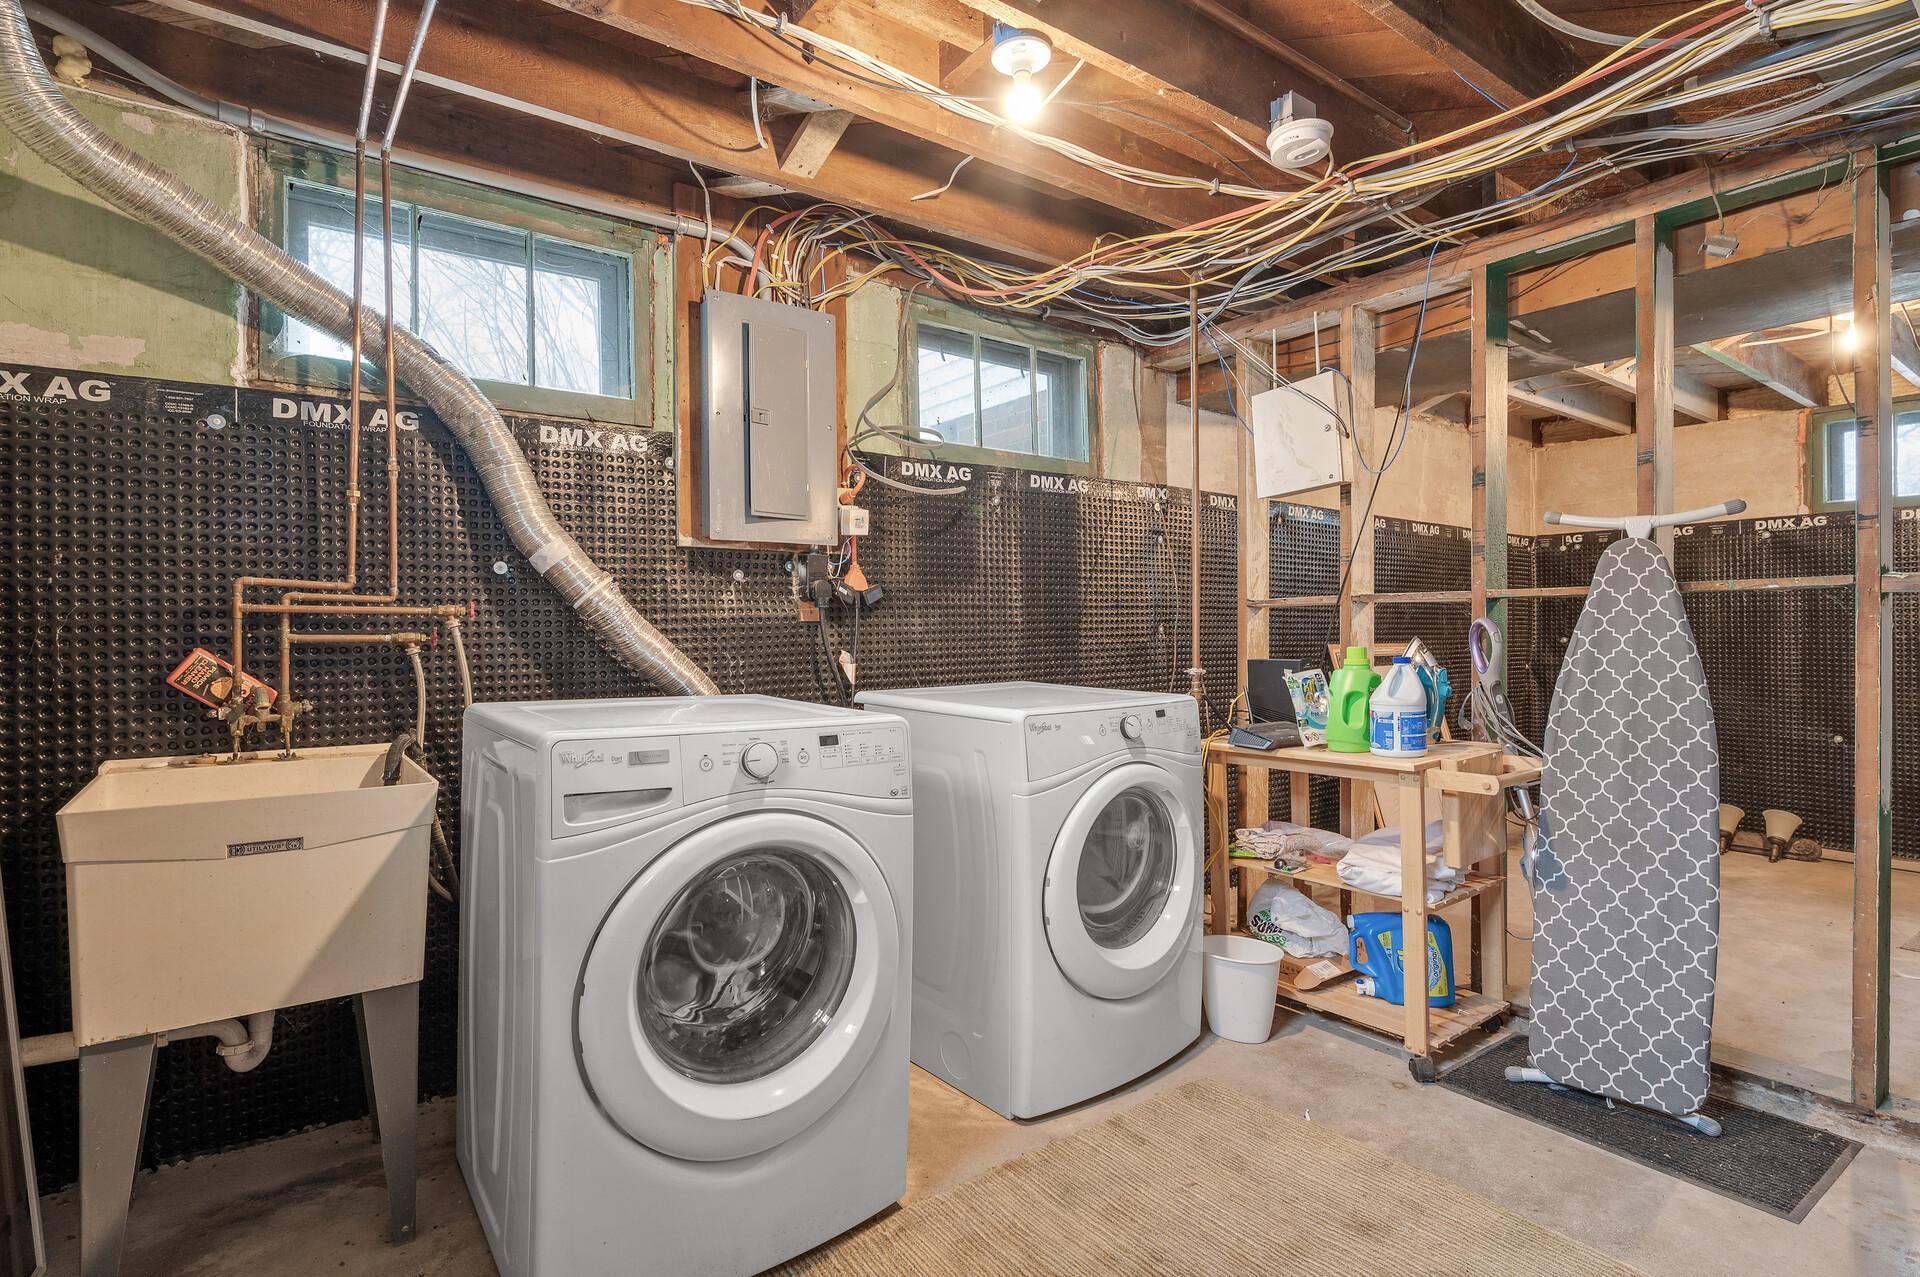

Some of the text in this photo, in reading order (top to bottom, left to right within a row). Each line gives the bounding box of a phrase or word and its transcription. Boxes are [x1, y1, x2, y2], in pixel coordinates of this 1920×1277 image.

[43, 376, 111, 402] AG
[33, 396, 67, 405] WRAP
[272, 397, 420, 430] DMX AG
[303, 420, 388, 433] FOUNDATI WRAP
[540, 425, 648, 452] DMX AG
[901, 461, 943, 479] DMX
[946, 466, 972, 481] AG
[1030, 474, 1089, 493] DMX AG
[1137, 486, 1168, 500] DMX
[1210, 495, 1236, 508] DMX
[1288, 506, 1324, 520] DMX AG
[1374, 518, 1386, 528] AG
[1412, 522, 1429, 534] DMX
[1429, 525, 1440, 535] AG
[1755, 517, 1797, 531] DMX
[1800, 515, 1828, 528] AG
[1673, 526, 1694, 537] AG
[1507, 535, 1520, 546] DMX
[1565, 535, 1583, 545] AG
[180, 659, 209, 686] CLEANER
[191, 665, 210, 684] HAND
[193, 666, 217, 689] PUMICE
